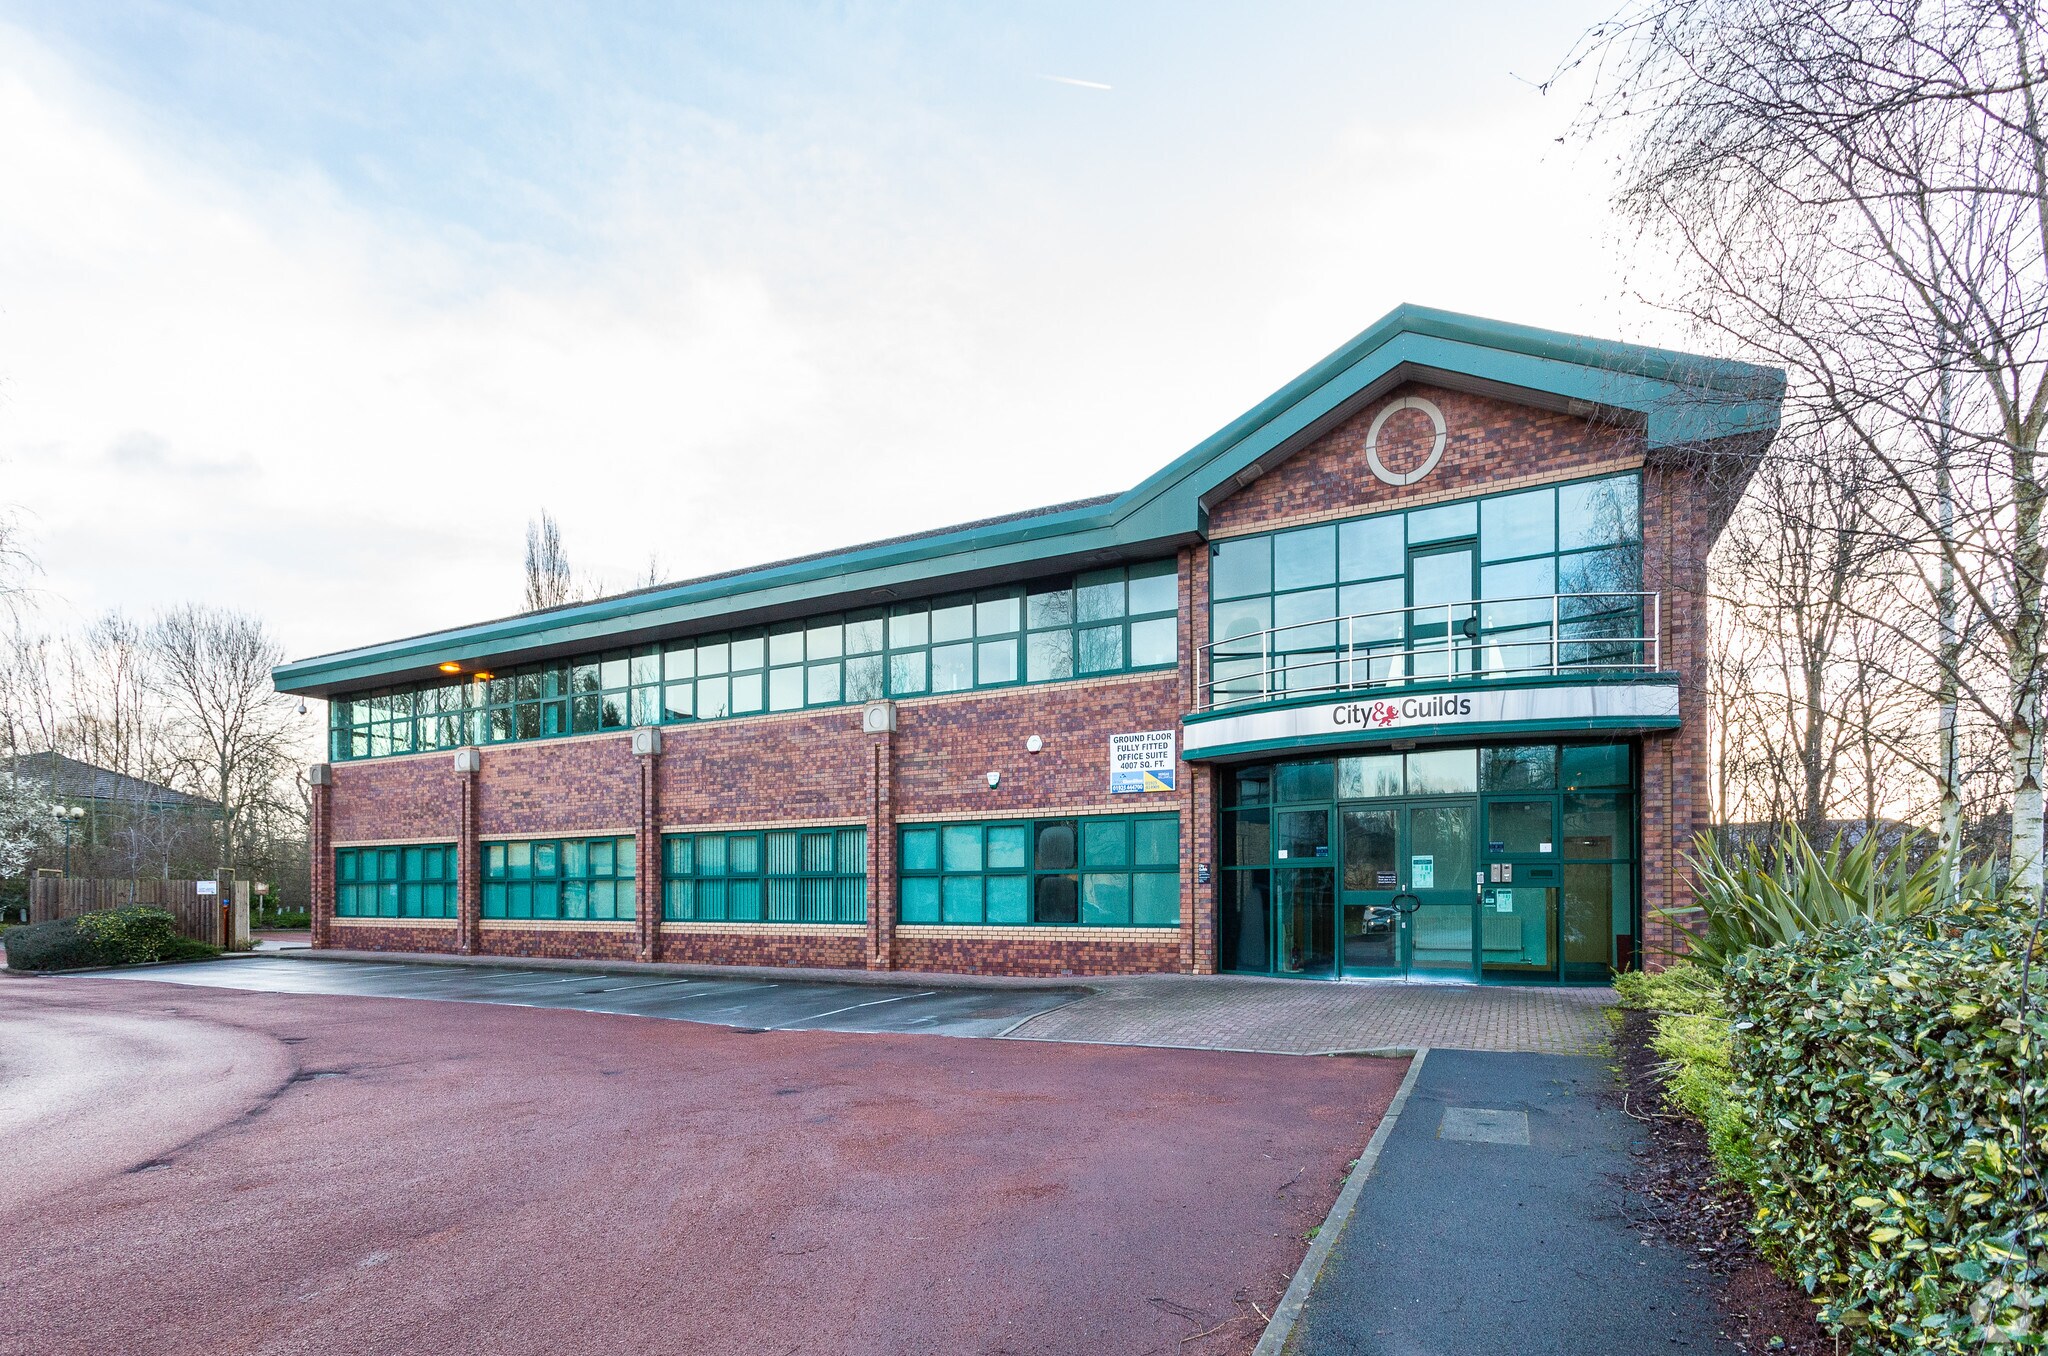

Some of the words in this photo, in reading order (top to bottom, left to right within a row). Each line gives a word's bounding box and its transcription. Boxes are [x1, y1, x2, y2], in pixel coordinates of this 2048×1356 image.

[1402, 695, 1471, 719] Guilds
[1113, 734, 1144, 743] GROUND
[1117, 744, 1140, 752] FULLY
[1142, 742, 1168, 750] FITTED
[1118, 752, 1144, 761] OFFICE
[1146, 751, 1168, 759] SUITE
